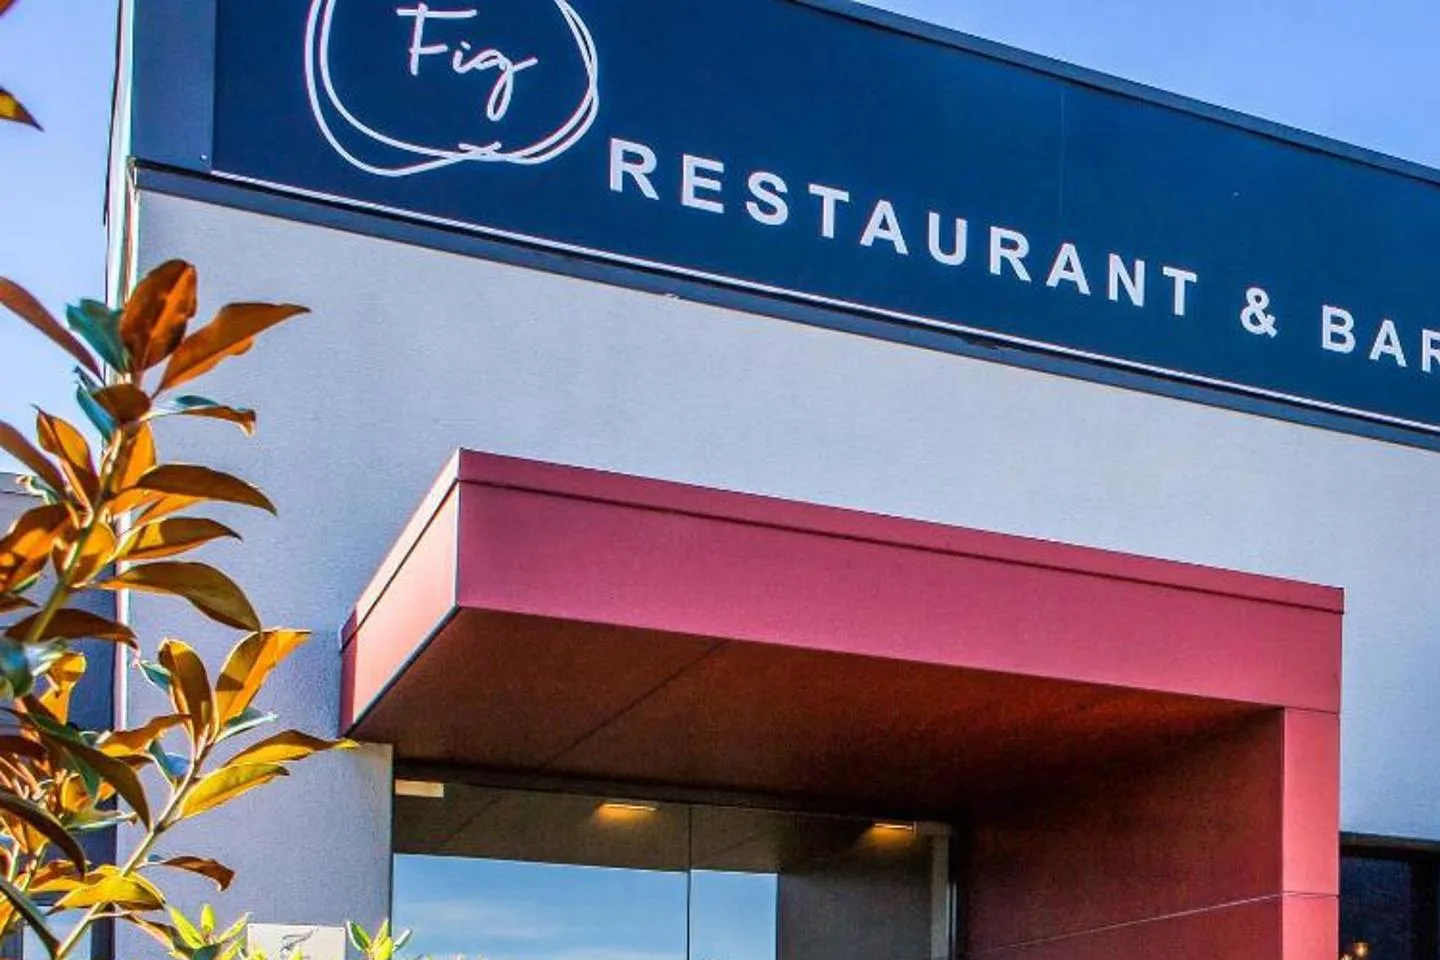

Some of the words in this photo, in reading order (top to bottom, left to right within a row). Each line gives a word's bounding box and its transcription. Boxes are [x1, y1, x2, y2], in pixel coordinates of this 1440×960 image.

[396, 3, 538, 120] Fig
[609, 137, 1198, 316] RESTAURANT
[1240, 287, 1277, 338] &
